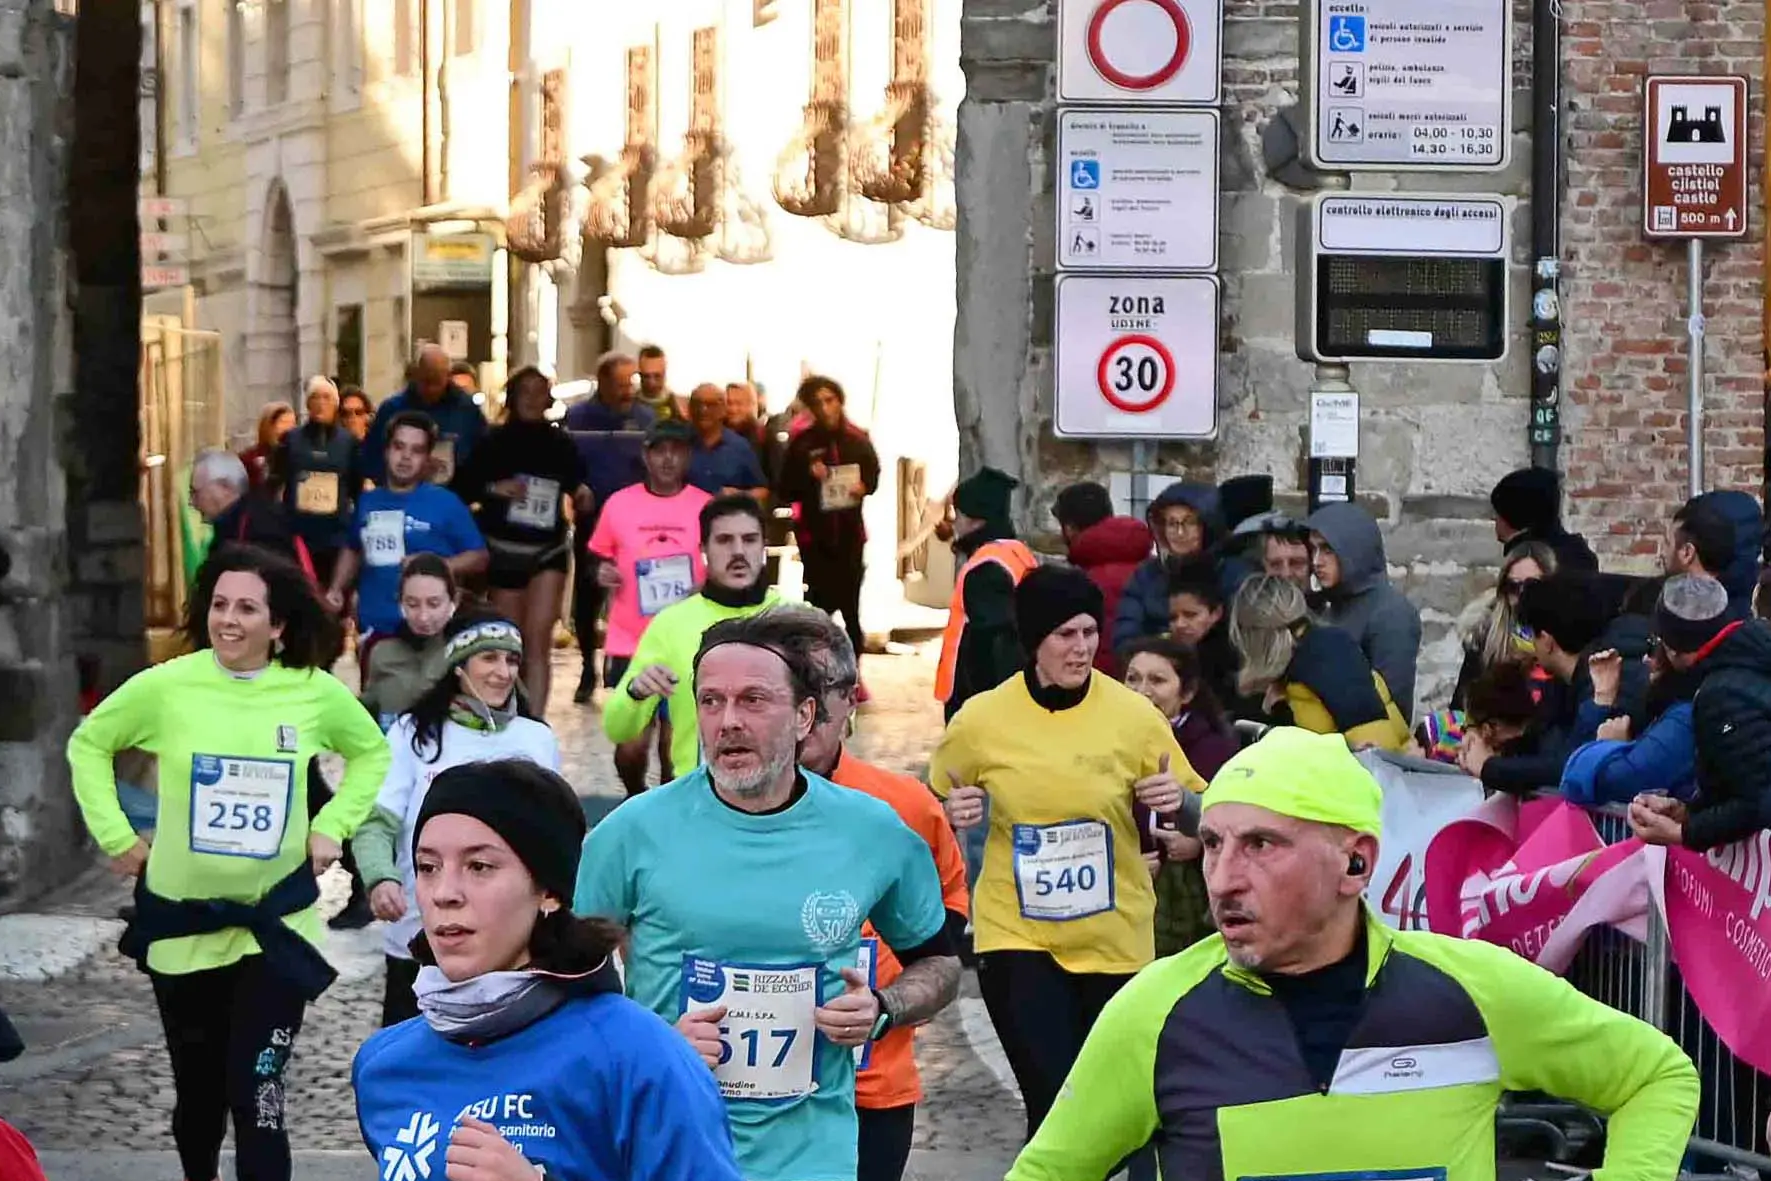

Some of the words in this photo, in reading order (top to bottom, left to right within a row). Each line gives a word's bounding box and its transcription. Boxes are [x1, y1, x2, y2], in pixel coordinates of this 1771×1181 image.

[1668, 165, 1724, 178] castello
[1674, 191, 1718, 204] castle
[1326, 205, 1373, 216] controllo
[1376, 205, 1431, 217] elettronico
[1434, 206, 1459, 219] degli
[1462, 207, 1497, 219] accessi
[1681, 212, 1705, 224] 500
[1710, 214, 1721, 224] m
[1109, 296, 1165, 315] zona
[1115, 355, 1158, 392] 30
[208, 801, 272, 832] 258
[1035, 864, 1096, 896] 540
[754, 974, 801, 984] RIZZANI
[753, 984, 769, 994] DE
[771, 980, 814, 994] ECCHER
[504, 1094, 534, 1119] FC
